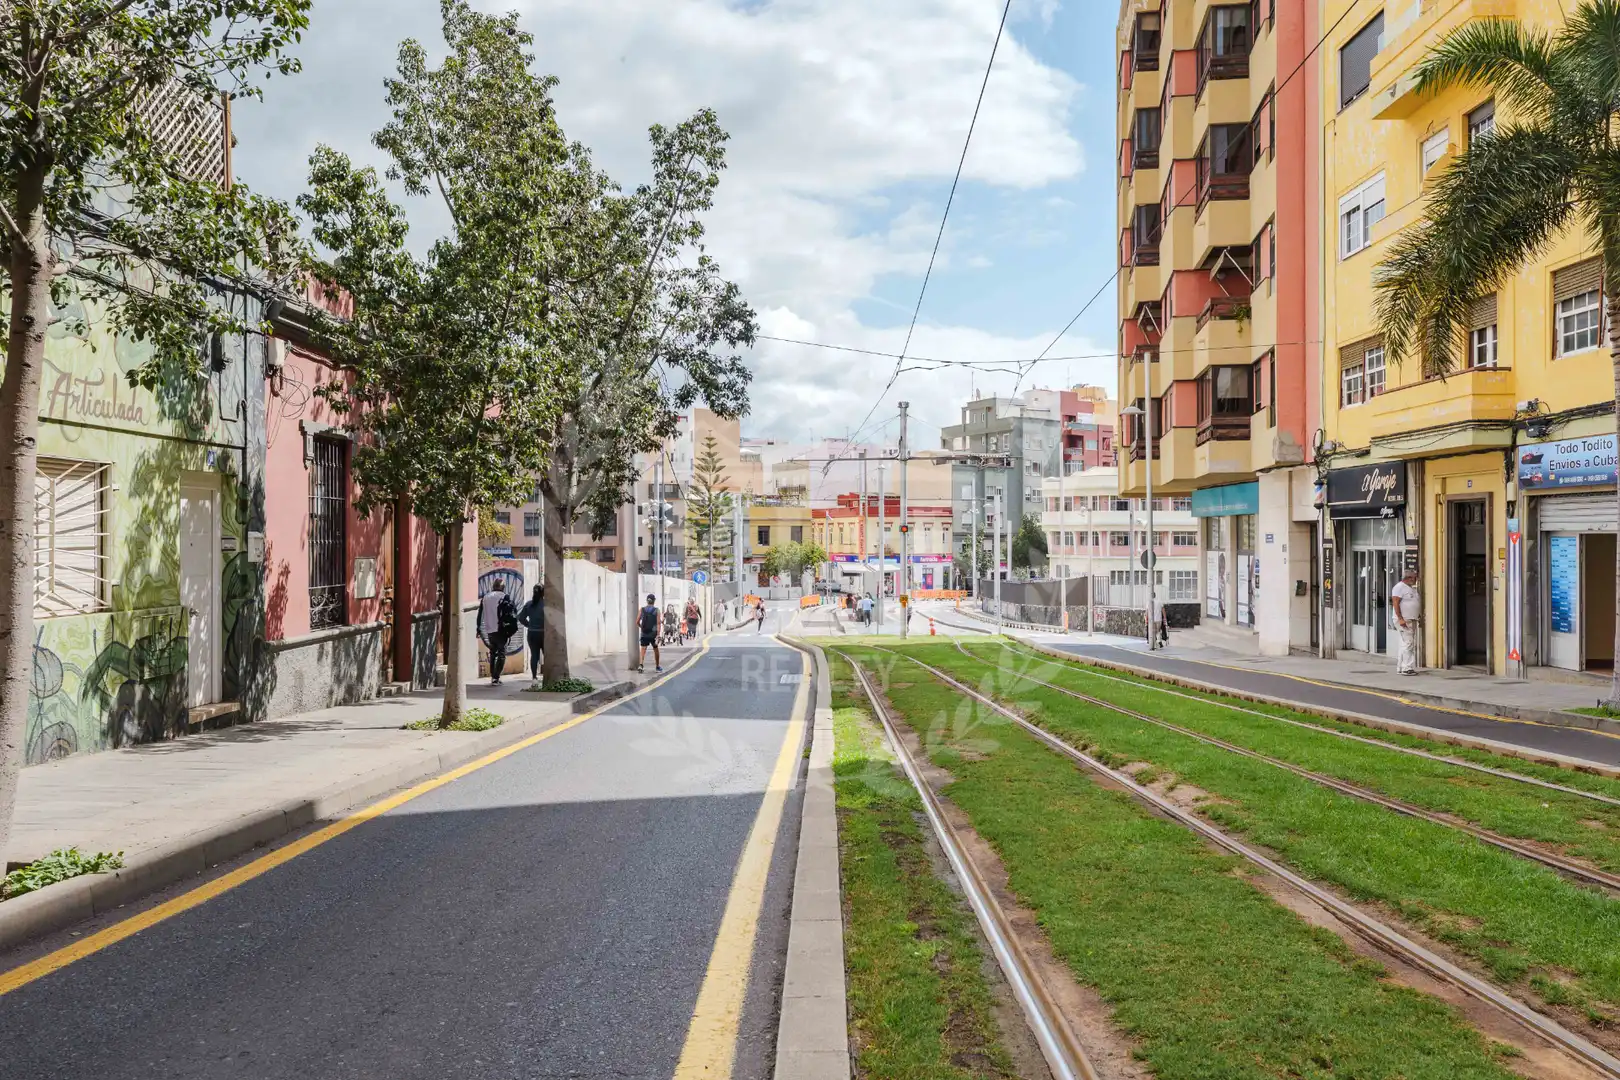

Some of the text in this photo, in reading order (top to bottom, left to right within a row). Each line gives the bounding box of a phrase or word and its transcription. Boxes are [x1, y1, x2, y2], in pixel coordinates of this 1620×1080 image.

[46, 366, 151, 426] Articulada
[1555, 438, 1613, 455] Todo Todito
[1549, 454, 1618, 471] Envios a Cuba
